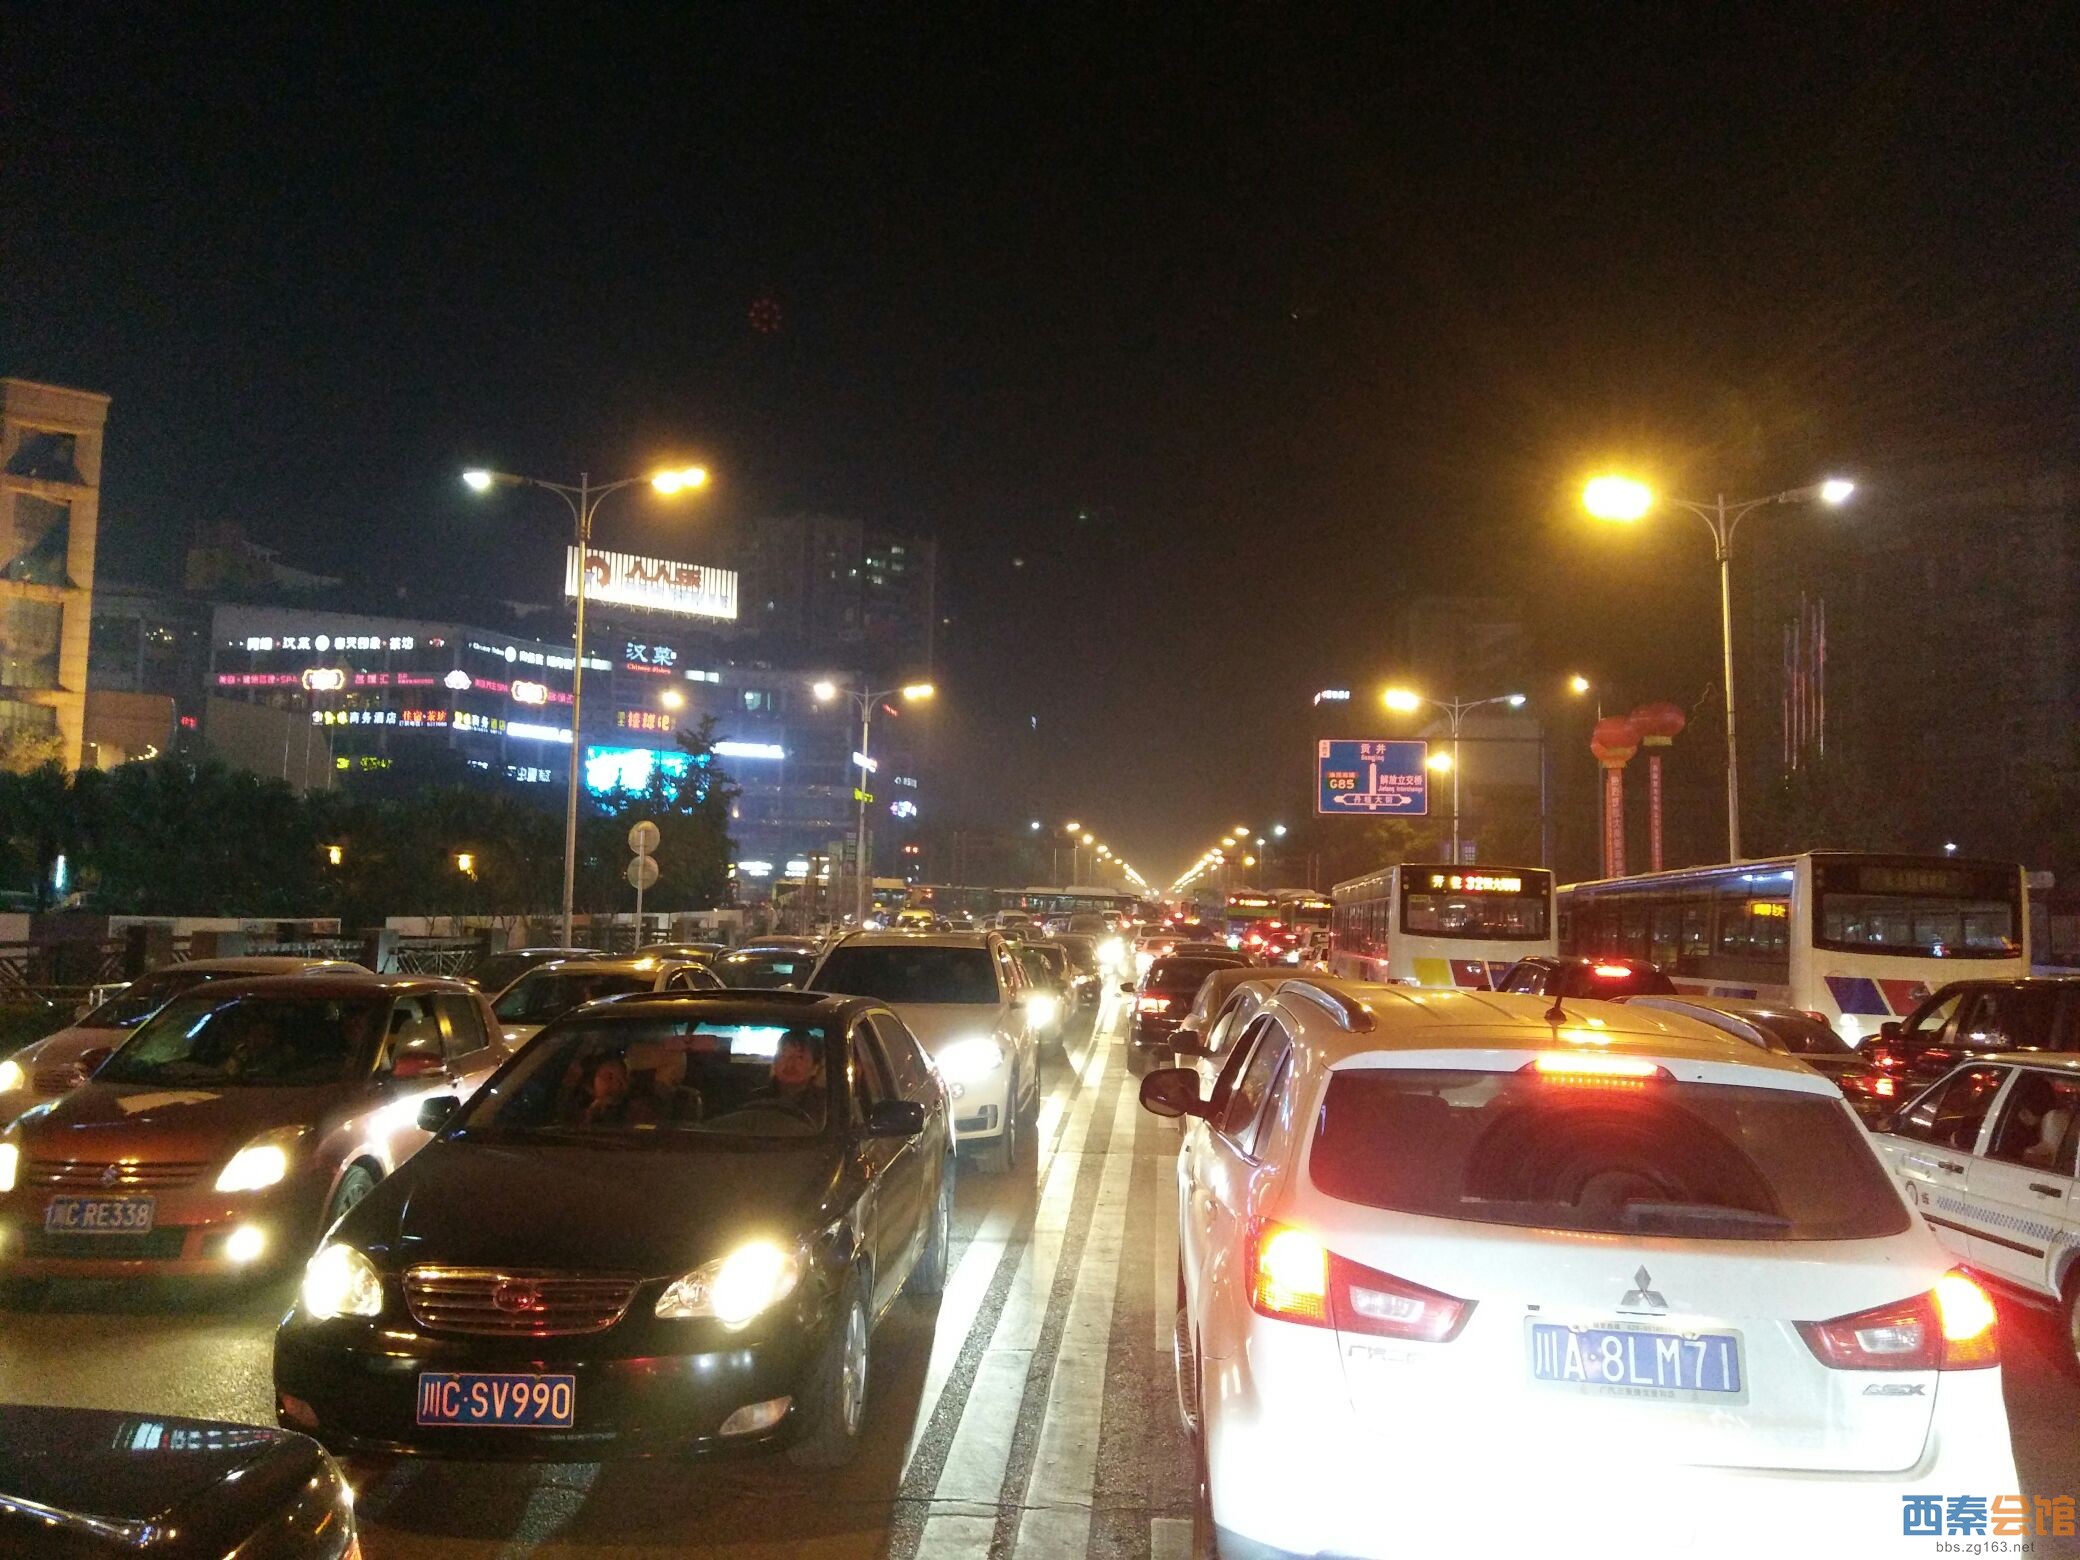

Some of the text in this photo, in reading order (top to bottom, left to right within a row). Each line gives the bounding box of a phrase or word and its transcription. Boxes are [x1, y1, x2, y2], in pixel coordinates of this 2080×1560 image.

[626, 642, 674, 667] 汉菜
[1361, 743, 1386, 755] 贡井
[1329, 779, 1355, 789] G85
[1380, 774, 1423, 786] 解放立交桥
